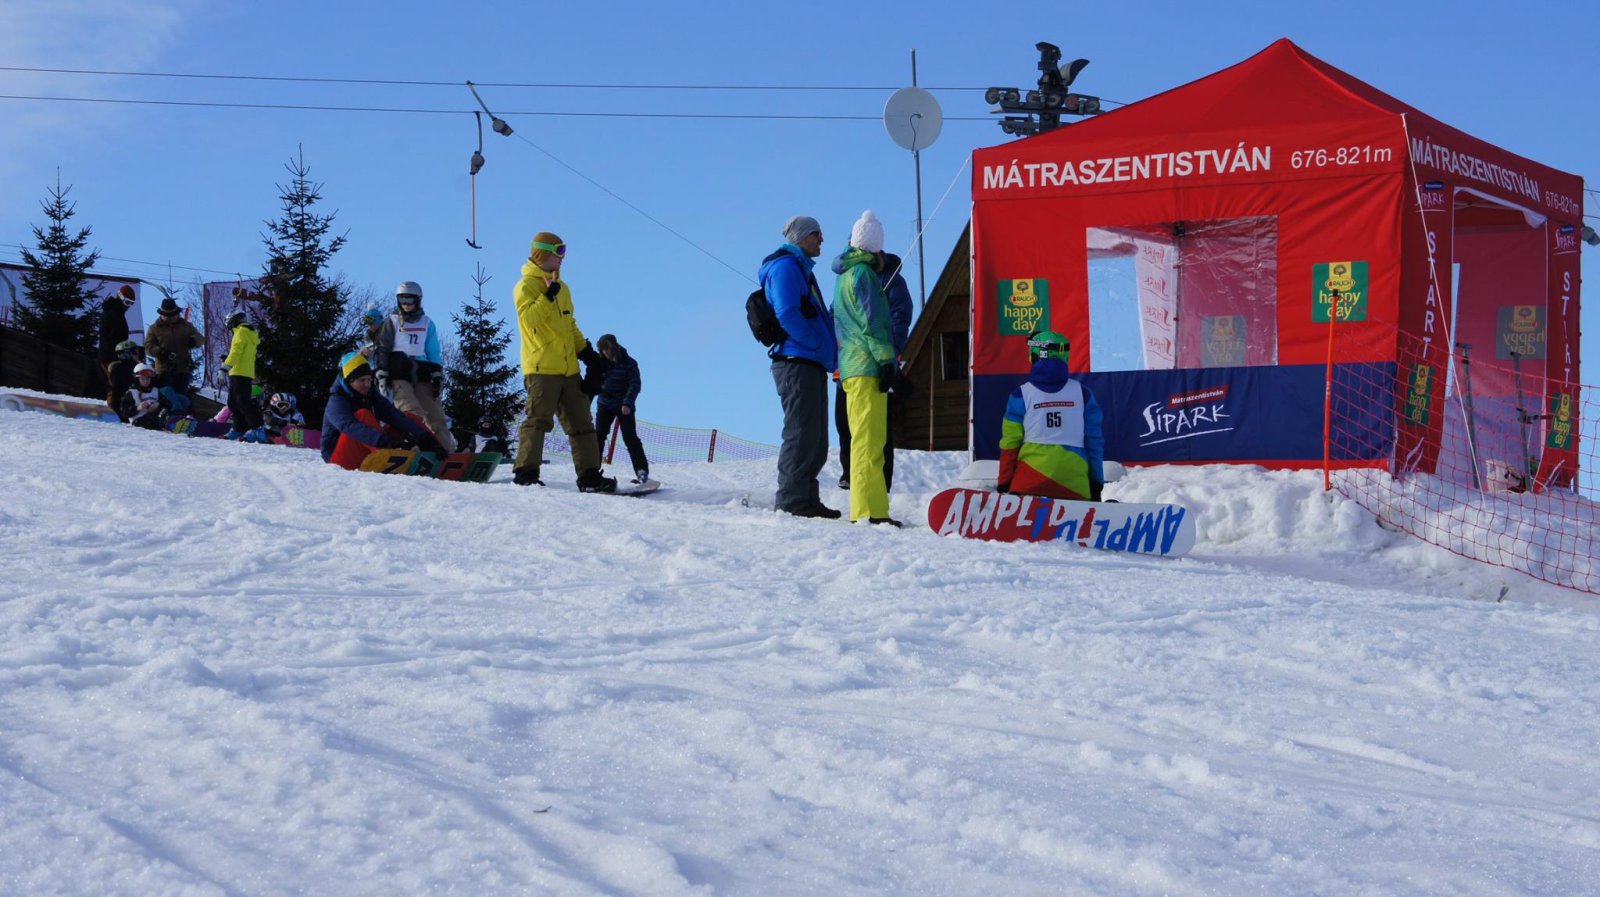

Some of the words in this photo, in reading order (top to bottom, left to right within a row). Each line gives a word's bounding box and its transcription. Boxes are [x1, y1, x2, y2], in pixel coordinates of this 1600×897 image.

[983, 142, 1271, 190] MÁTRASZENTISTVÁN
[1291, 146, 1391, 169] 676-821m
[1412, 136, 1540, 202] MÁTRASZENTISTVÁN
[1545, 191, 1579, 216] 676-821m
[1423, 231, 1436, 358] START
[1004, 304, 1043, 320] happy
[1012, 318, 1037, 333] day
[408, 334, 419, 345] 72
[1046, 411, 1062, 428] 65
